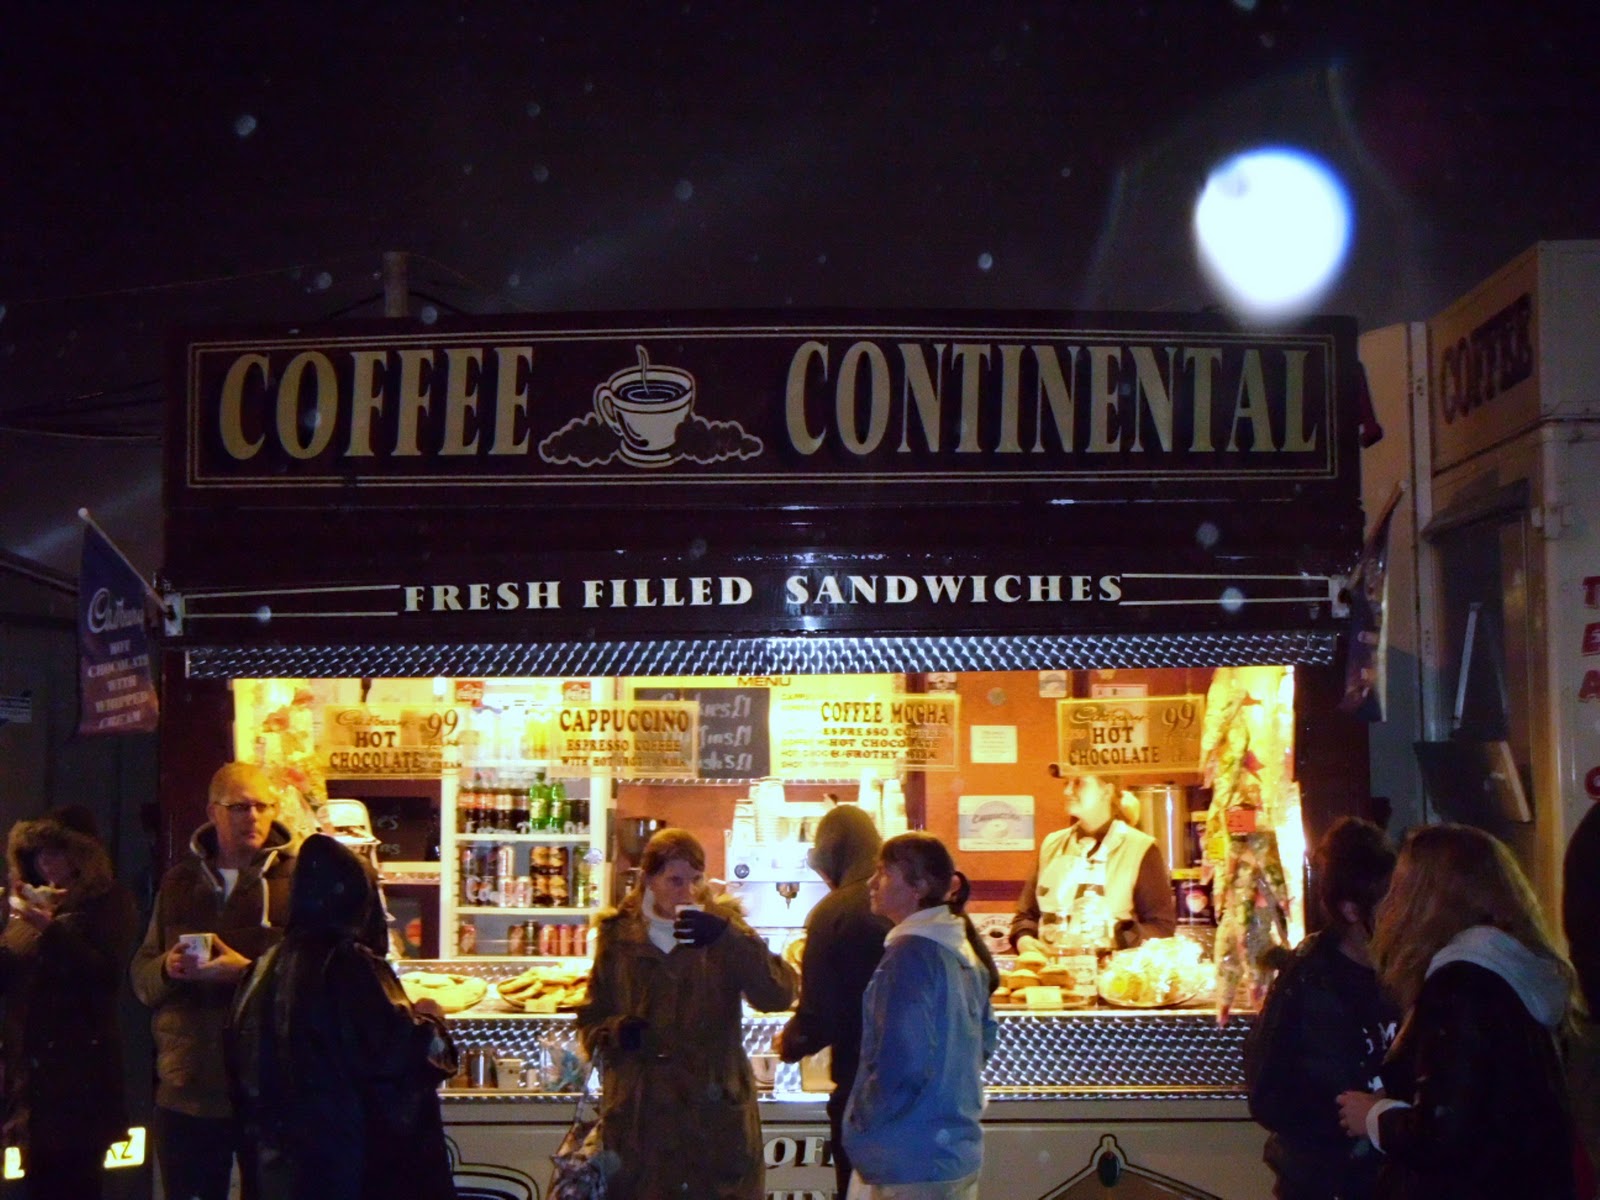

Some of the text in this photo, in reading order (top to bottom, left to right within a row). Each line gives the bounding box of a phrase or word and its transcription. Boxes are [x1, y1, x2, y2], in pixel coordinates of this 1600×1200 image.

[218, 340, 1318, 461] COFFEE CONTINENTAL
[404, 574, 1122, 613] FRESH FILLED SANDWICHES
[737, 676, 791, 687] MENU
[559, 708, 690, 733] CAPPUCCINO
[820, 701, 949, 725] COFFEE MOCHA
[355, 731, 397, 749] HOT
[823, 727, 889, 738] ESPRESSO
[1092, 726, 1135, 744] HOT
[566, 739, 629, 752] ESPRESSO
[829, 738, 857, 748] HOT
[329, 751, 422, 772] CHOCOLATE
[1068, 746, 1160, 766] CHOCOLATE
